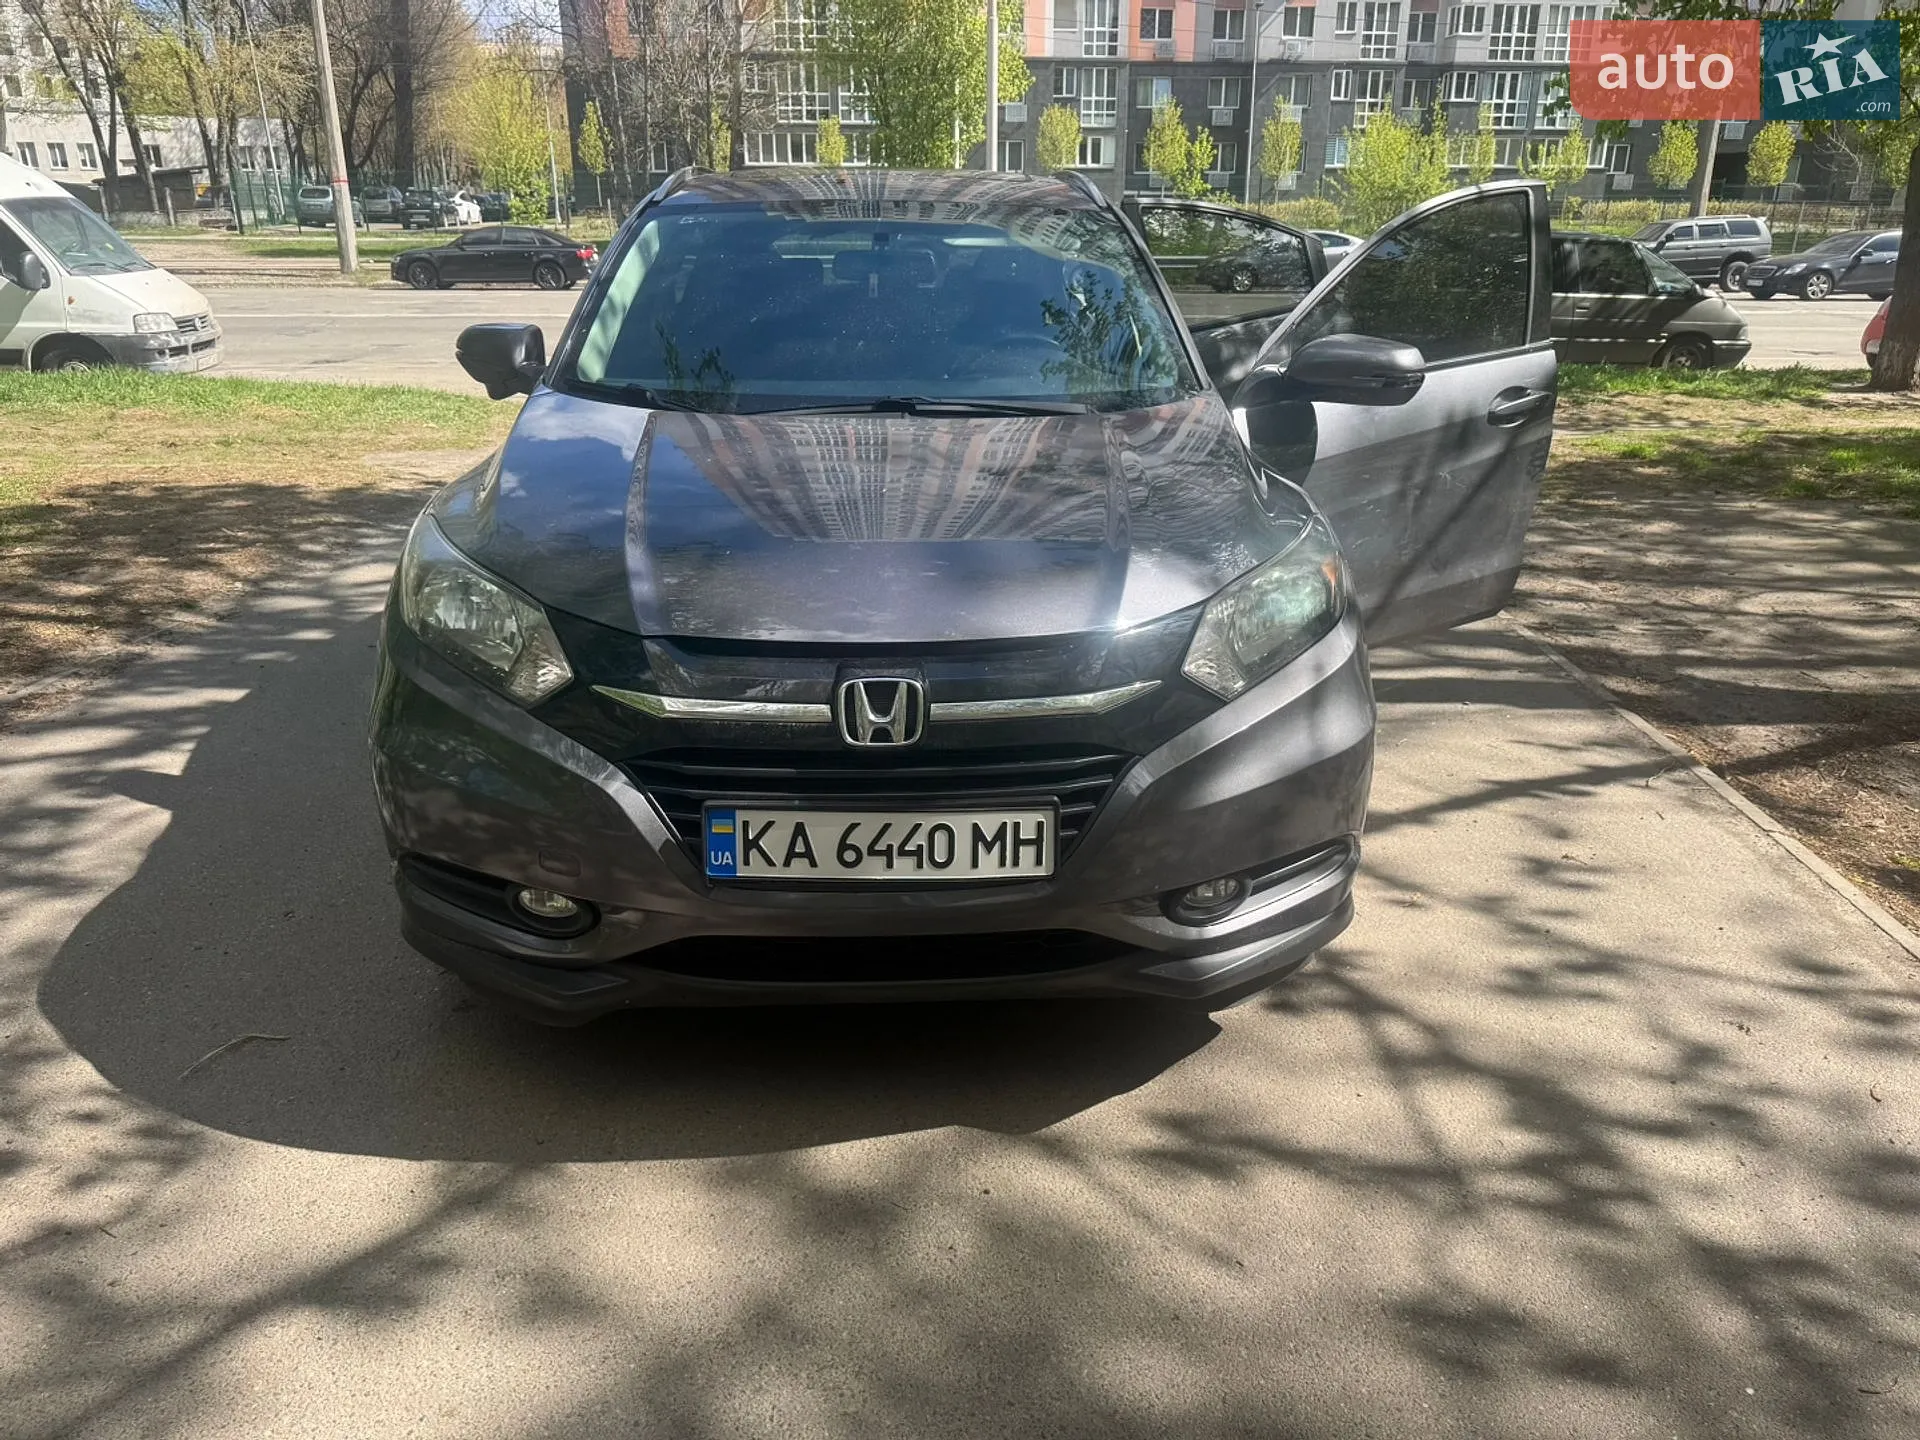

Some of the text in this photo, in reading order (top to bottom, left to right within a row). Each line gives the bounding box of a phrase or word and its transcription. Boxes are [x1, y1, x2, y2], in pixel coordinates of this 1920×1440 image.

[710, 851, 733, 865] UA
[741, 819, 1046, 869] KA 6440 MH
